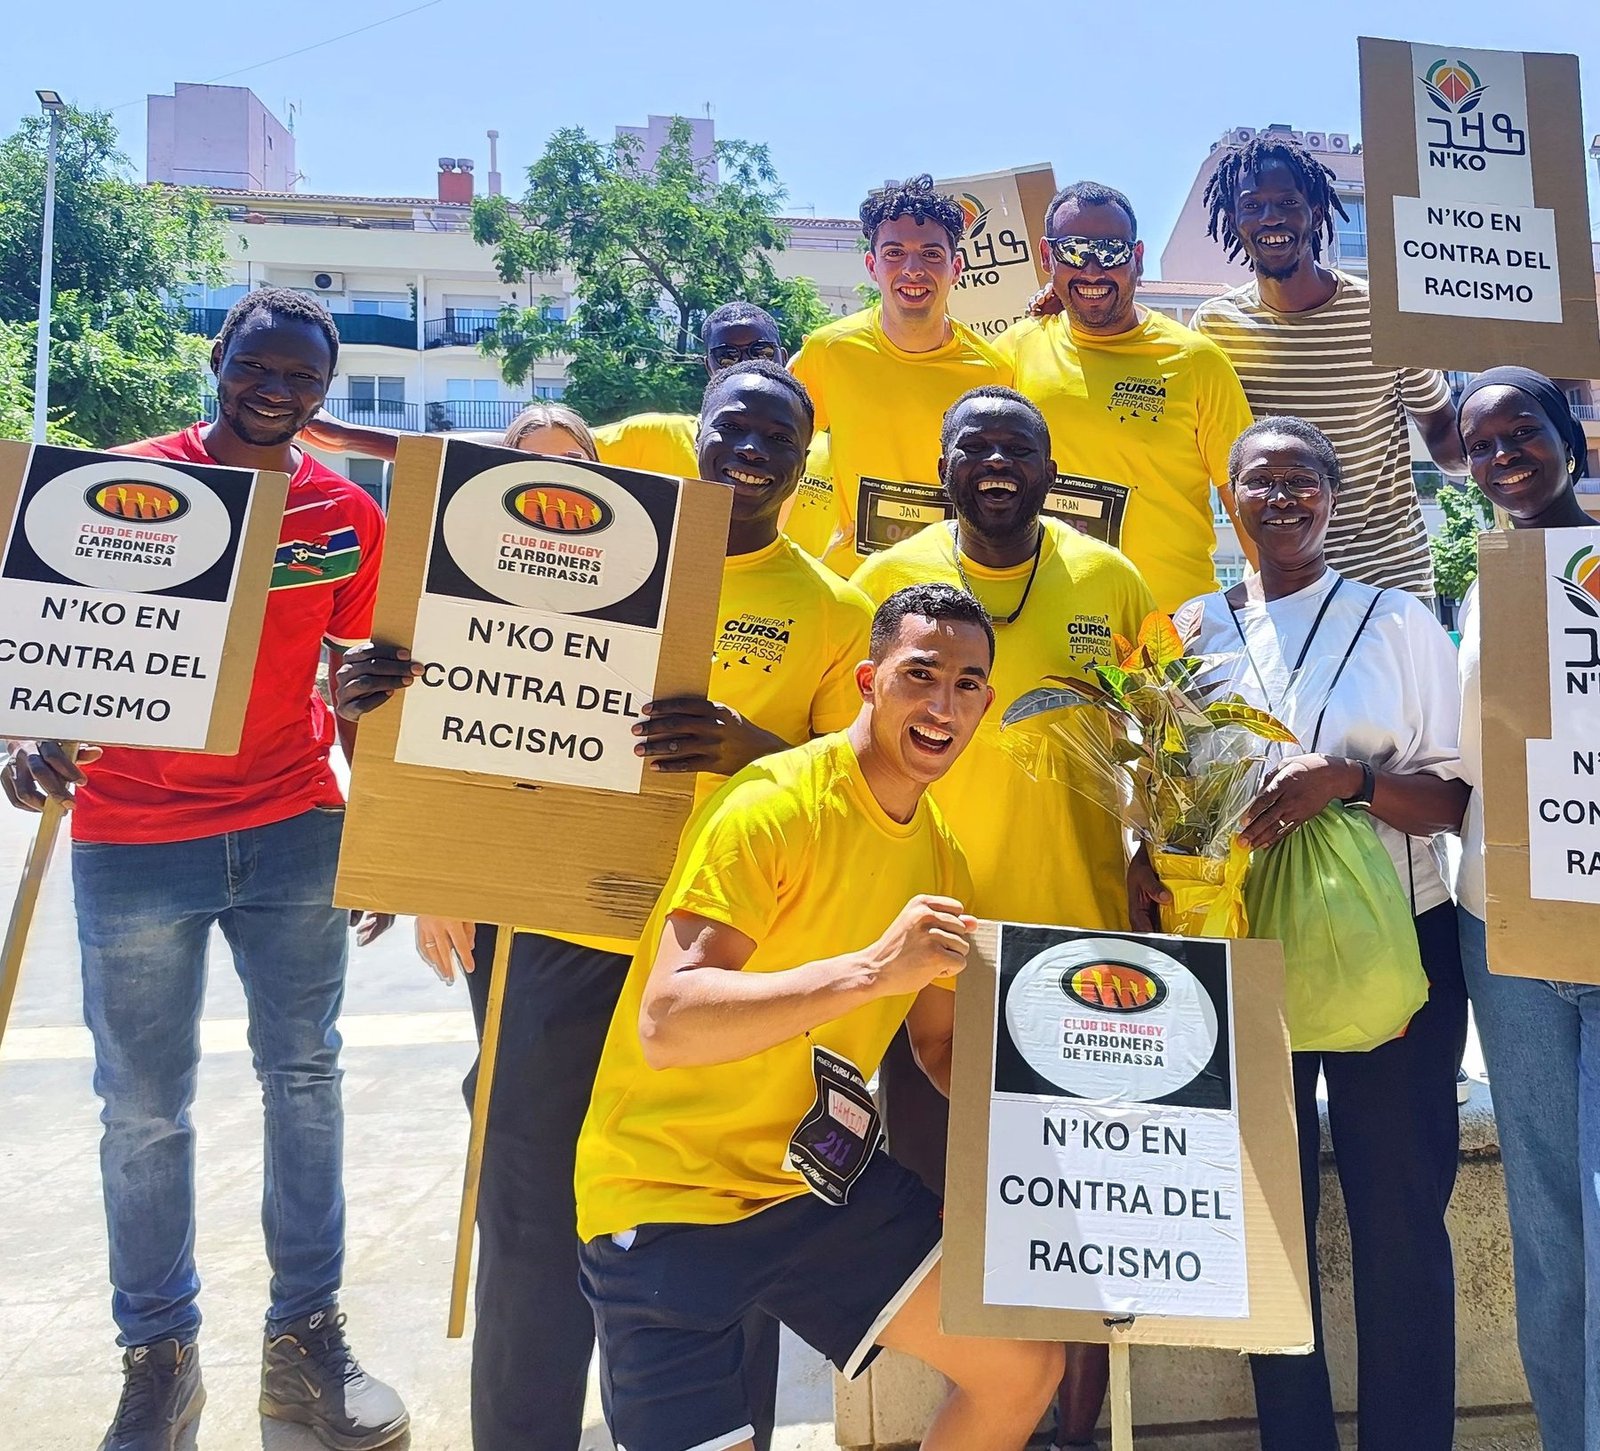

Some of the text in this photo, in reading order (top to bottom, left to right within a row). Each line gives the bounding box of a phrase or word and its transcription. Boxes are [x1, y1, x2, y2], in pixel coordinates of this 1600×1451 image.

[1429, 151, 1486, 171] N'KO
[1427, 207, 1522, 233] N’KO EN
[1403, 240, 1551, 270] CONTRA DEL
[1425, 276, 1533, 303] RACISMO
[1114, 382, 1166, 398] CURSA
[1126, 376, 1162, 386] PRIMERA
[1110, 398, 1164, 414] TERRASSA
[1112, 392, 1166, 406] ANTIRACISTA
[800, 477, 833, 492] URSA
[880, 484, 901, 493] CURSA
[899, 505, 920, 518] JAN
[1056, 498, 1079, 511] FRAN
[81, 524, 178, 543] CLUB DE RUGBY
[78, 535, 176, 555] CARBONERS
[502, 533, 603, 558] CLUB DE RUGBY
[75, 547, 172, 567] DE TERRASSA
[500, 546, 602, 572] CARBONERS
[498, 559, 599, 585] DE TERRASSA
[41, 597, 181, 631] N’KO EN
[740, 613, 786, 628] PRIMERA
[468, 617, 610, 663] N’KO EN
[724, 620, 790, 644] CURSA
[1067, 623, 1111, 638] CURSA
[716, 640, 782, 664] TERRASSA
[720, 633, 786, 653] ANTIRACISTA
[0, 639, 207, 679] CONTRA DEL
[421, 662, 640, 718] CONTRA DEL
[9, 687, 172, 722] RACISMO
[442, 716, 604, 762] RACISMO
[1063, 1018, 1164, 1037] CLUB DE RUGBY
[1063, 1032, 1164, 1052] CARBONERS
[1063, 1047, 1164, 1067] DE TERRASSA
[832, 1064, 850, 1080] CURSA
[1043, 1117, 1187, 1156] N’KO EN
[999, 1174, 1232, 1221] CONTRA DEL
[1029, 1239, 1202, 1282] RACISMO
